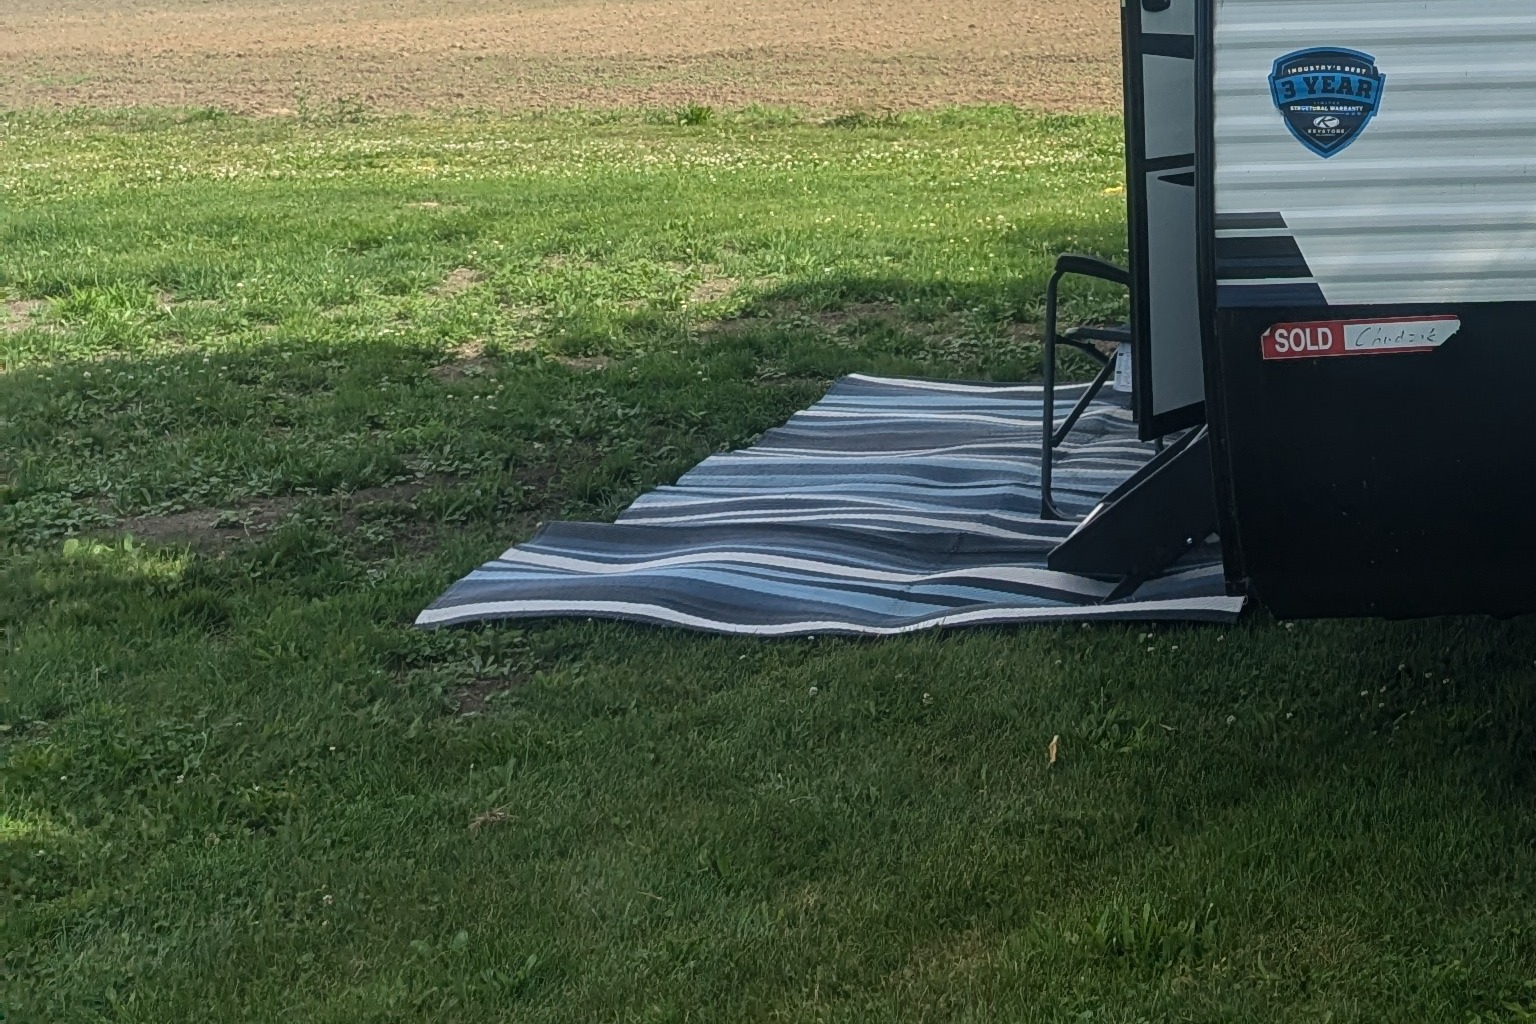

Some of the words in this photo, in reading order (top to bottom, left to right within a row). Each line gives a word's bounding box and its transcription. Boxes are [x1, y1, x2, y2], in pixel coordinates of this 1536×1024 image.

[1281, 79, 1296, 99] 3
[1302, 75, 1373, 99] YEAR
[1274, 327, 1333, 353] SOLD
